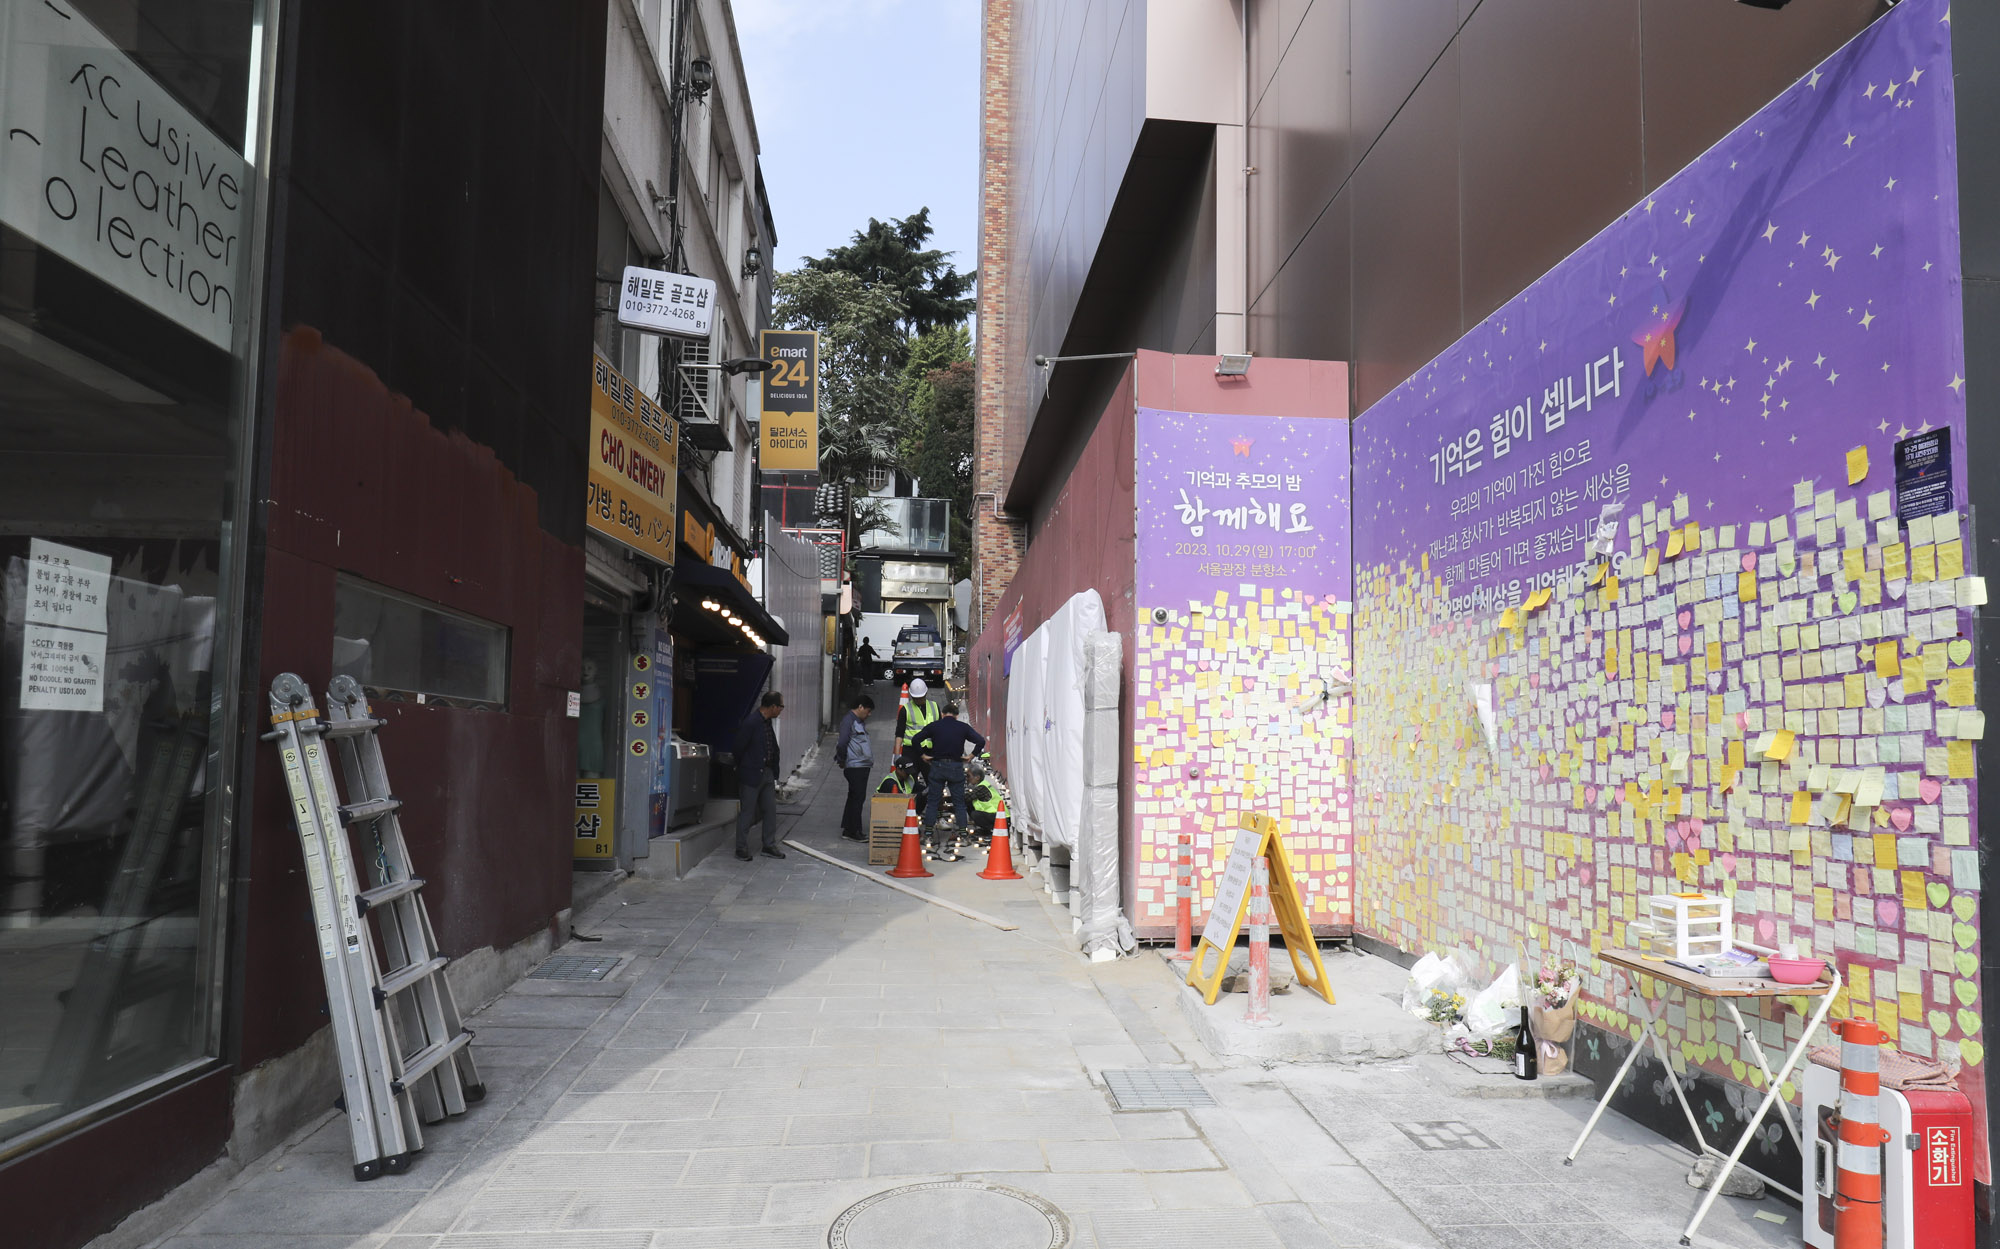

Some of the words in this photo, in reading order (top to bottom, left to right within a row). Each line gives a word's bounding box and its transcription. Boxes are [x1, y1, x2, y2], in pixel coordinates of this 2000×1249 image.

[80, 106, 236, 266] Leather
[627, 276, 665, 301] 해밀톤
[671, 283, 709, 308] 골프샵
[625, 300, 695, 320] 010-3772-4268
[696, 320, 706, 329] B1
[770, 346, 808, 358] emart
[770, 360, 810, 387] 24
[595, 359, 635, 415] 해밀톤
[640, 396, 673, 445] 골프샵
[1430, 428, 1484, 485] 기억은
[1490, 397, 1532, 459] 힘이
[1540, 346, 1625, 433] 셉니다
[611, 405, 659, 452] 010-3772-4268
[770, 427, 808, 438] 딜리셔스
[770, 439, 808, 449] 아이디어
[601, 428, 625, 474] CHO
[626, 447, 666, 499] JEWERY
[1186, 470, 1231, 489] 기억과
[1235, 472, 1281, 490] 추모의
[1285, 474, 1302, 491] 밤
[1450, 489, 1481, 521] 우리의
[1483, 472, 1517, 504] 기억이
[1520, 459, 1545, 489] 가진
[1549, 439, 1592, 478] 힘으로
[588, 482, 615, 524] 가방,
[620, 499, 644, 538] Bag,
[1174, 488, 1314, 537] 함께해요
[1429, 531, 1458, 560] 재난과
[1461, 517, 1494, 550] 참사가
[1497, 499, 1546, 537] 반복되지
[1550, 488, 1579, 517] 않는
[1583, 463, 1632, 502] 세상을
[1175, 542, 1211, 557] 2023.
[1280, 545, 1314, 559] 17:00
[1444, 560, 1466, 588] 함께
[1468, 548, 1502, 583] 만들어
[1505, 542, 1530, 566] 가면
[1197, 562, 1246, 578] 서울광장
[1250, 563, 1288, 578] 분향소
[901, 585, 929, 593] Atelier
[28, 685, 57, 694] PENALTY
[595, 843, 609, 854] B1
[1931, 1129, 1949, 1183] 소화기
